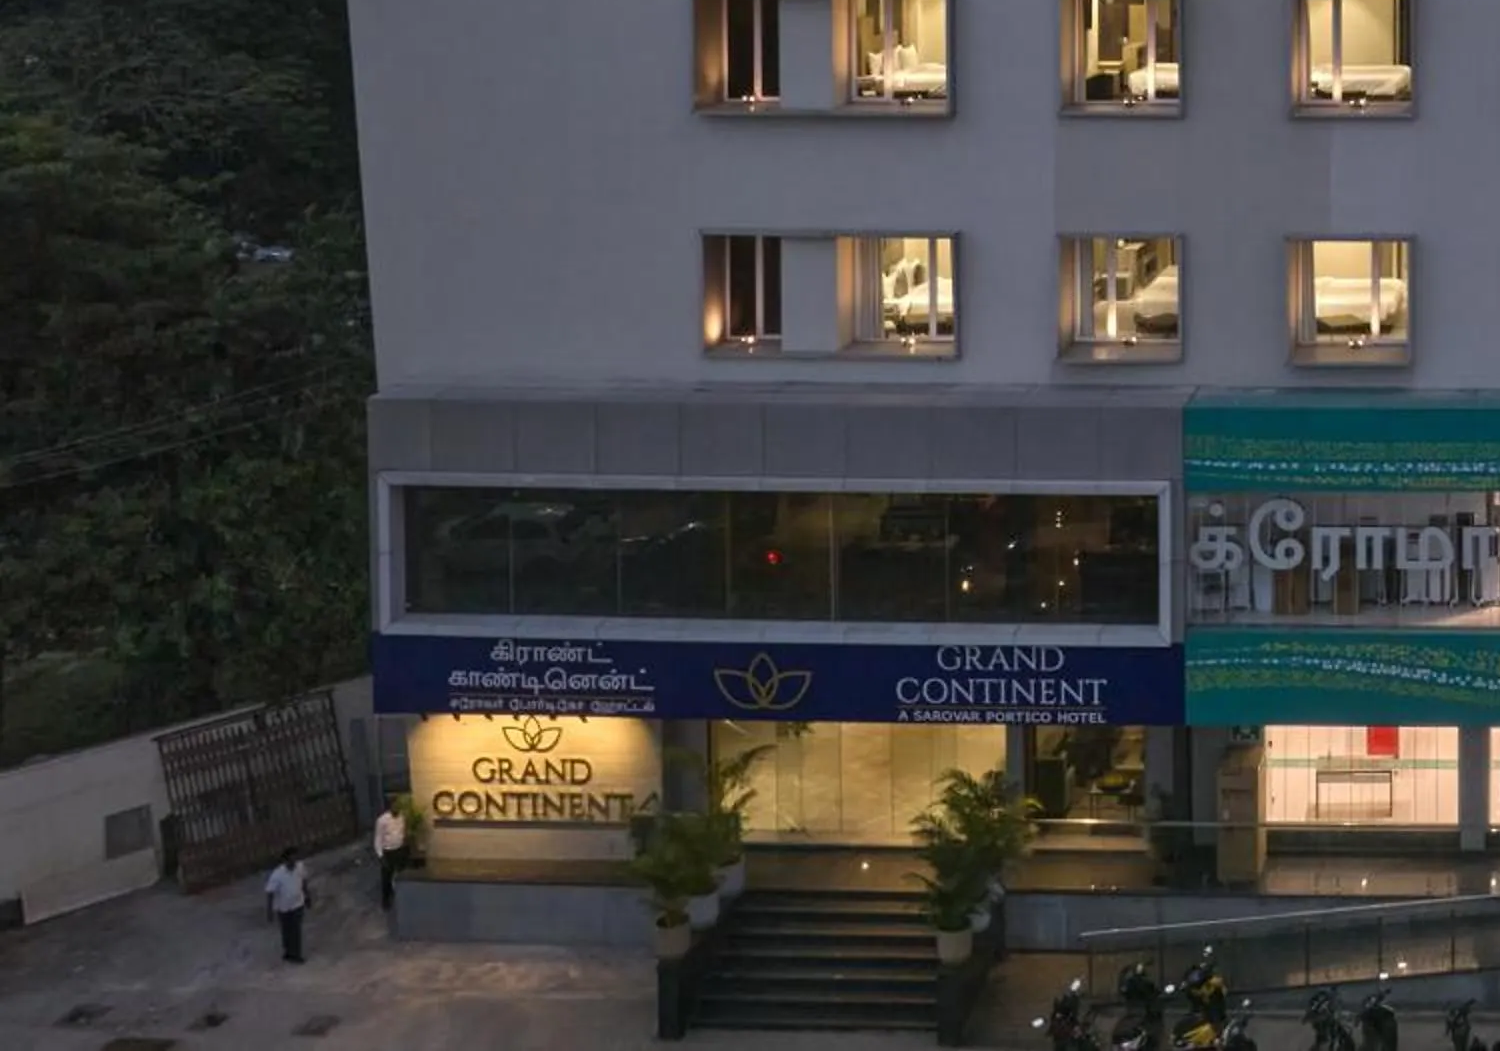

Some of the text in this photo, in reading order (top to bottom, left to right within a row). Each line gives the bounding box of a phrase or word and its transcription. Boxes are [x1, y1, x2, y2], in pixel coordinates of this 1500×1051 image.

[1190, 498, 1499, 581] க்ரோமா
[490, 638, 613, 665] கிராண்ட்
[936, 644, 1066, 671] GRAND
[895, 676, 1108, 705] CONTINENT
[898, 710, 1106, 724] A SAROVAR PORTICO HOTEL
[472, 757, 593, 785] GRAND
[433, 791, 634, 819] CONTINENT
